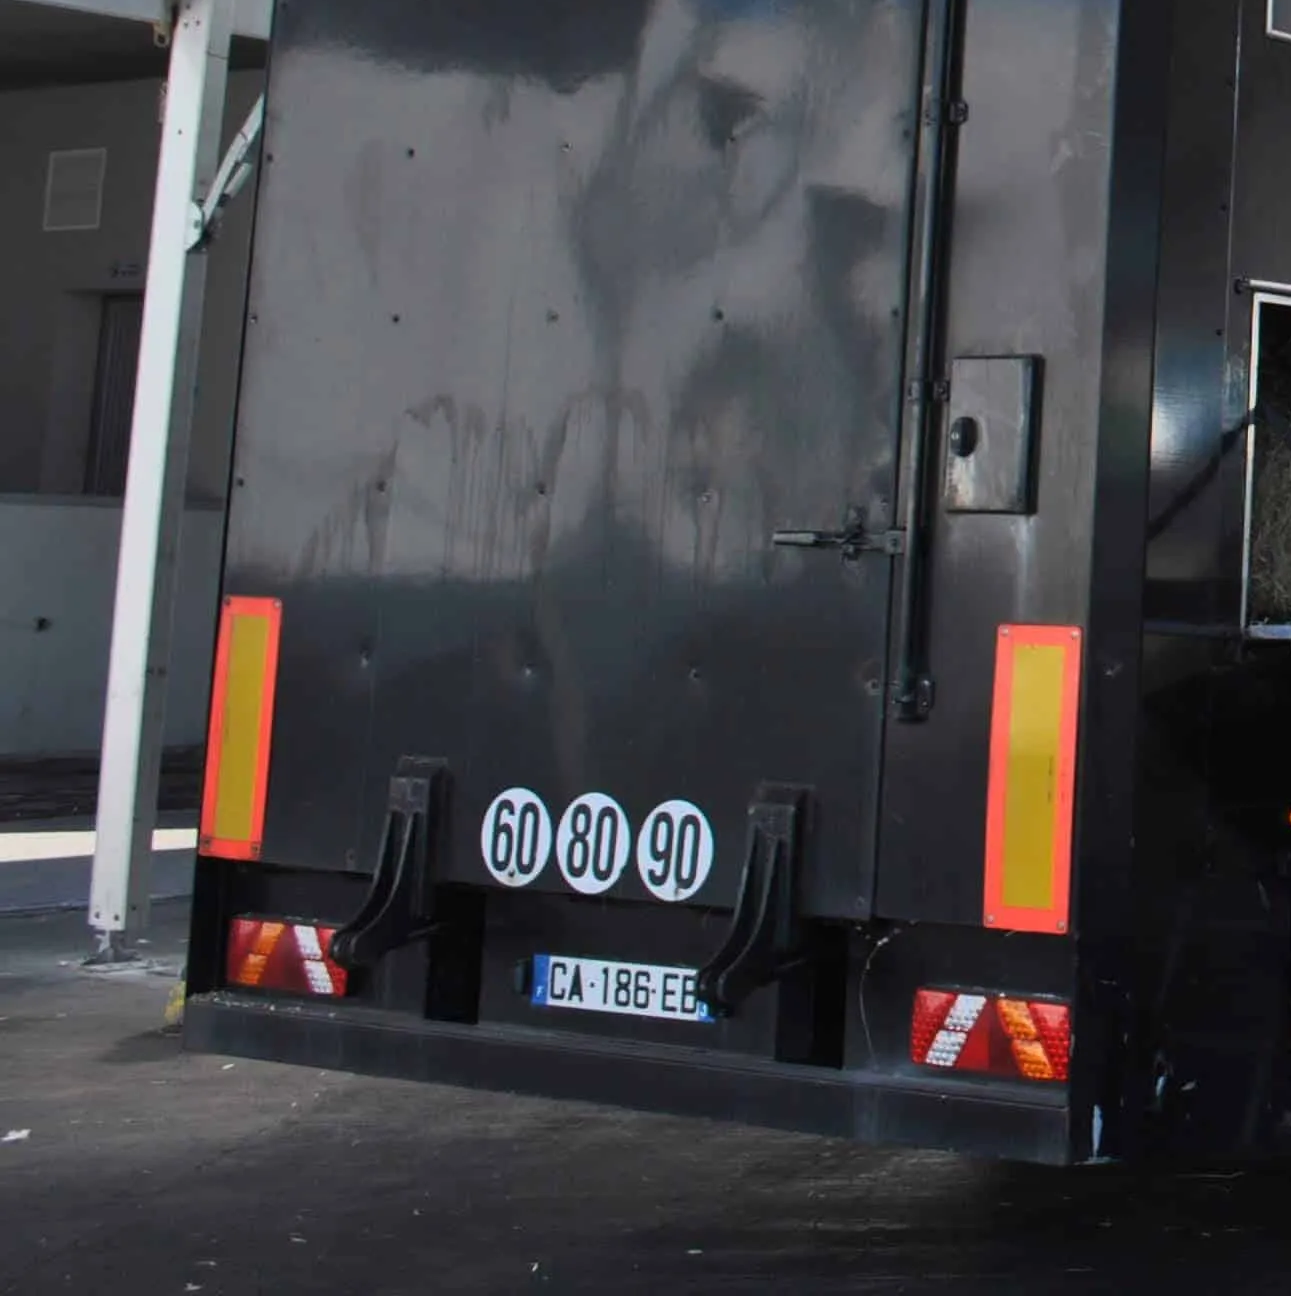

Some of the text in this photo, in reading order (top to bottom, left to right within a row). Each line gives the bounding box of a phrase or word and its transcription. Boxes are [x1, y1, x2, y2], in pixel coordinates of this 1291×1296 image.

[491, 799, 701, 889] 60 80 90
